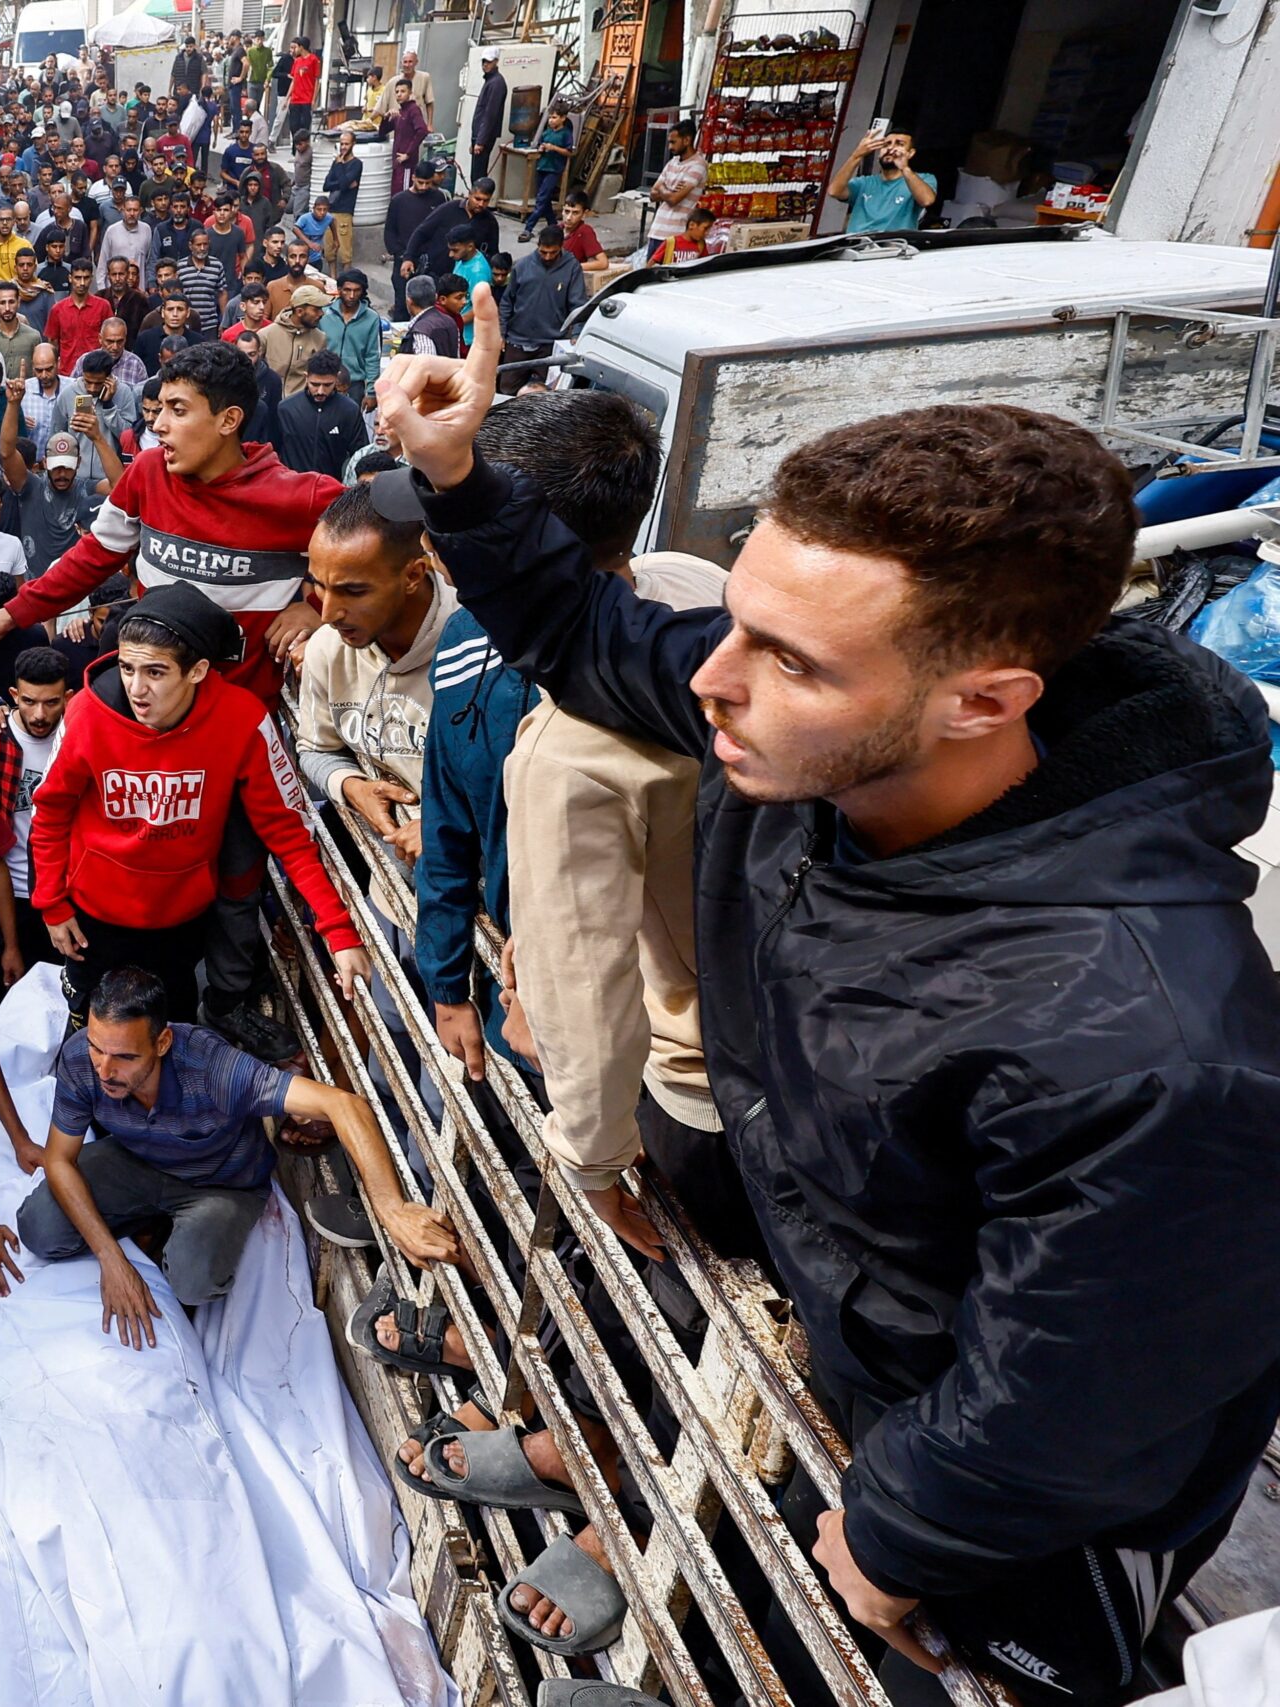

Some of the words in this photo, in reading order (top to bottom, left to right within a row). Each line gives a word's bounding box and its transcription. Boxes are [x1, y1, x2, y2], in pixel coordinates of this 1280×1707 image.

[149, 536, 252, 577] RACING
[167, 561, 180, 571] ON
[180, 565, 217, 578] STREETS
[103, 770, 202, 822] SPORT
[1001, 1640, 1061, 1682] NIKE
